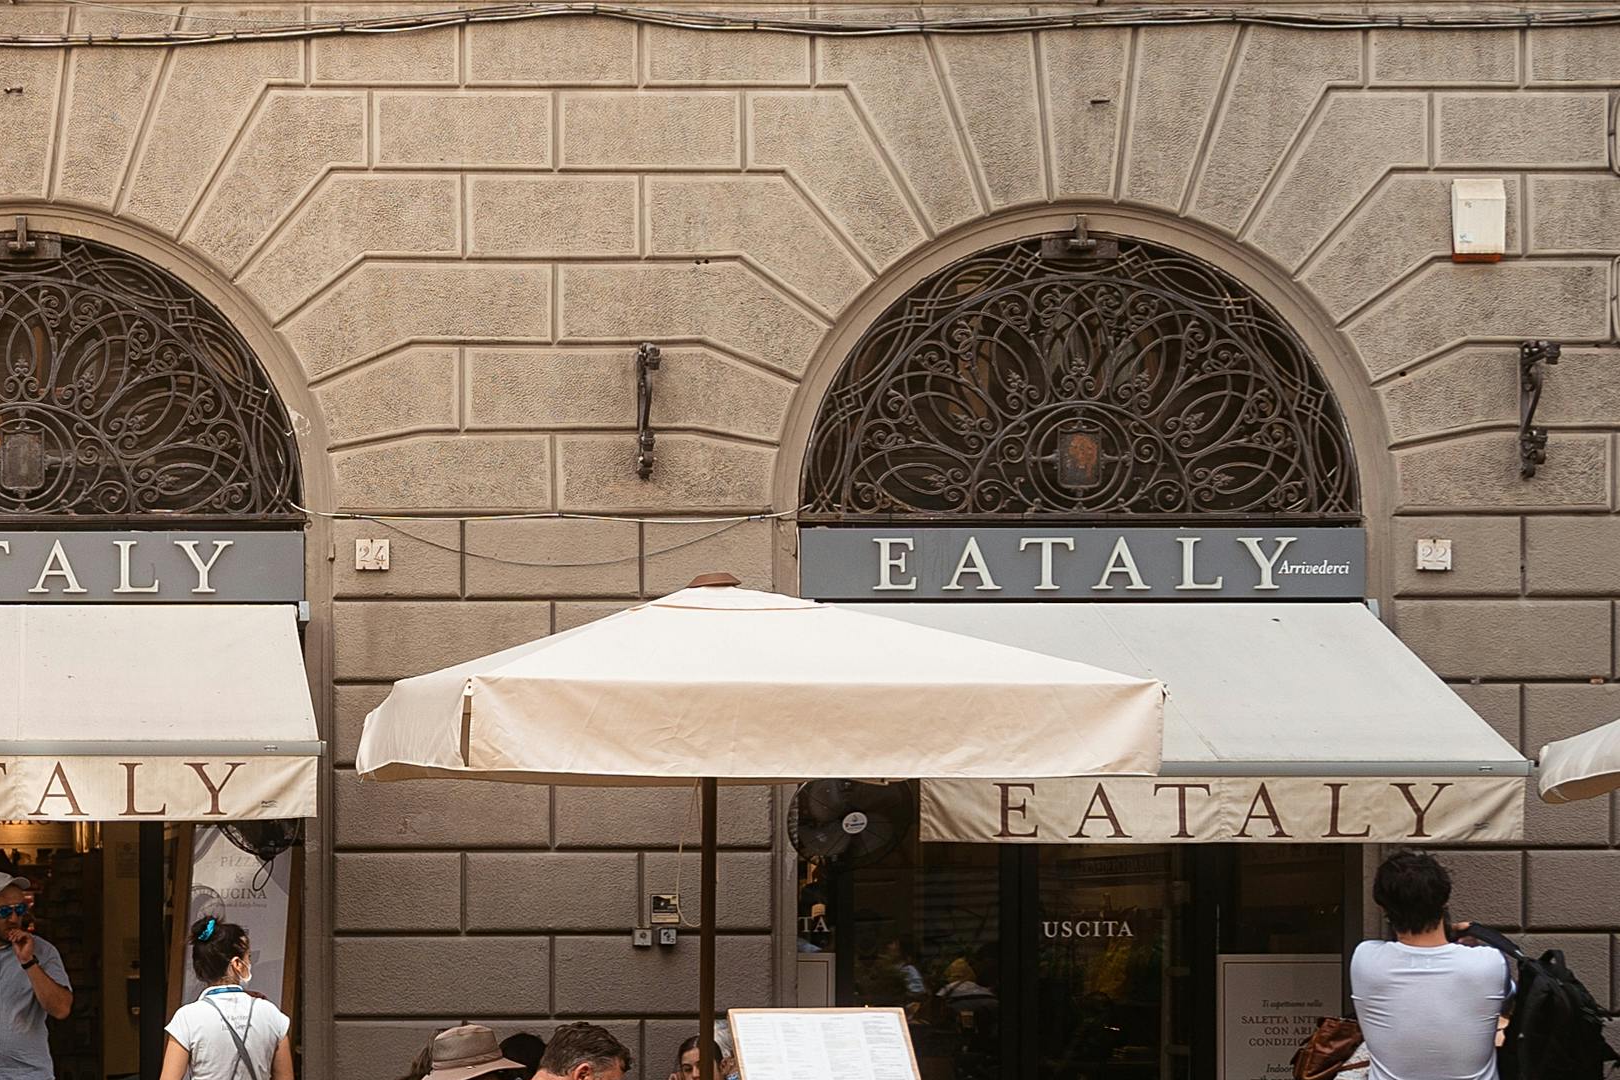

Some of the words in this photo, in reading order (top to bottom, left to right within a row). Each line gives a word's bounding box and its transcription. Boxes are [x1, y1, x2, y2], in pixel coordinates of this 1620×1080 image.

[358, 545, 387, 566] 24
[1422, 545, 1448, 563] 22
[873, 537, 1298, 591] EATALY
[1277, 559, 1350, 576] Arrivederci
[992, 782, 1454, 838] EATALY
[221, 888, 267, 899] UCINA
[1042, 921, 1134, 938] USCITA
[1241, 1016, 1289, 1025] SALETTA
[1264, 1027, 1289, 1035] CON
[1292, 1027, 1312, 1035] ARI
